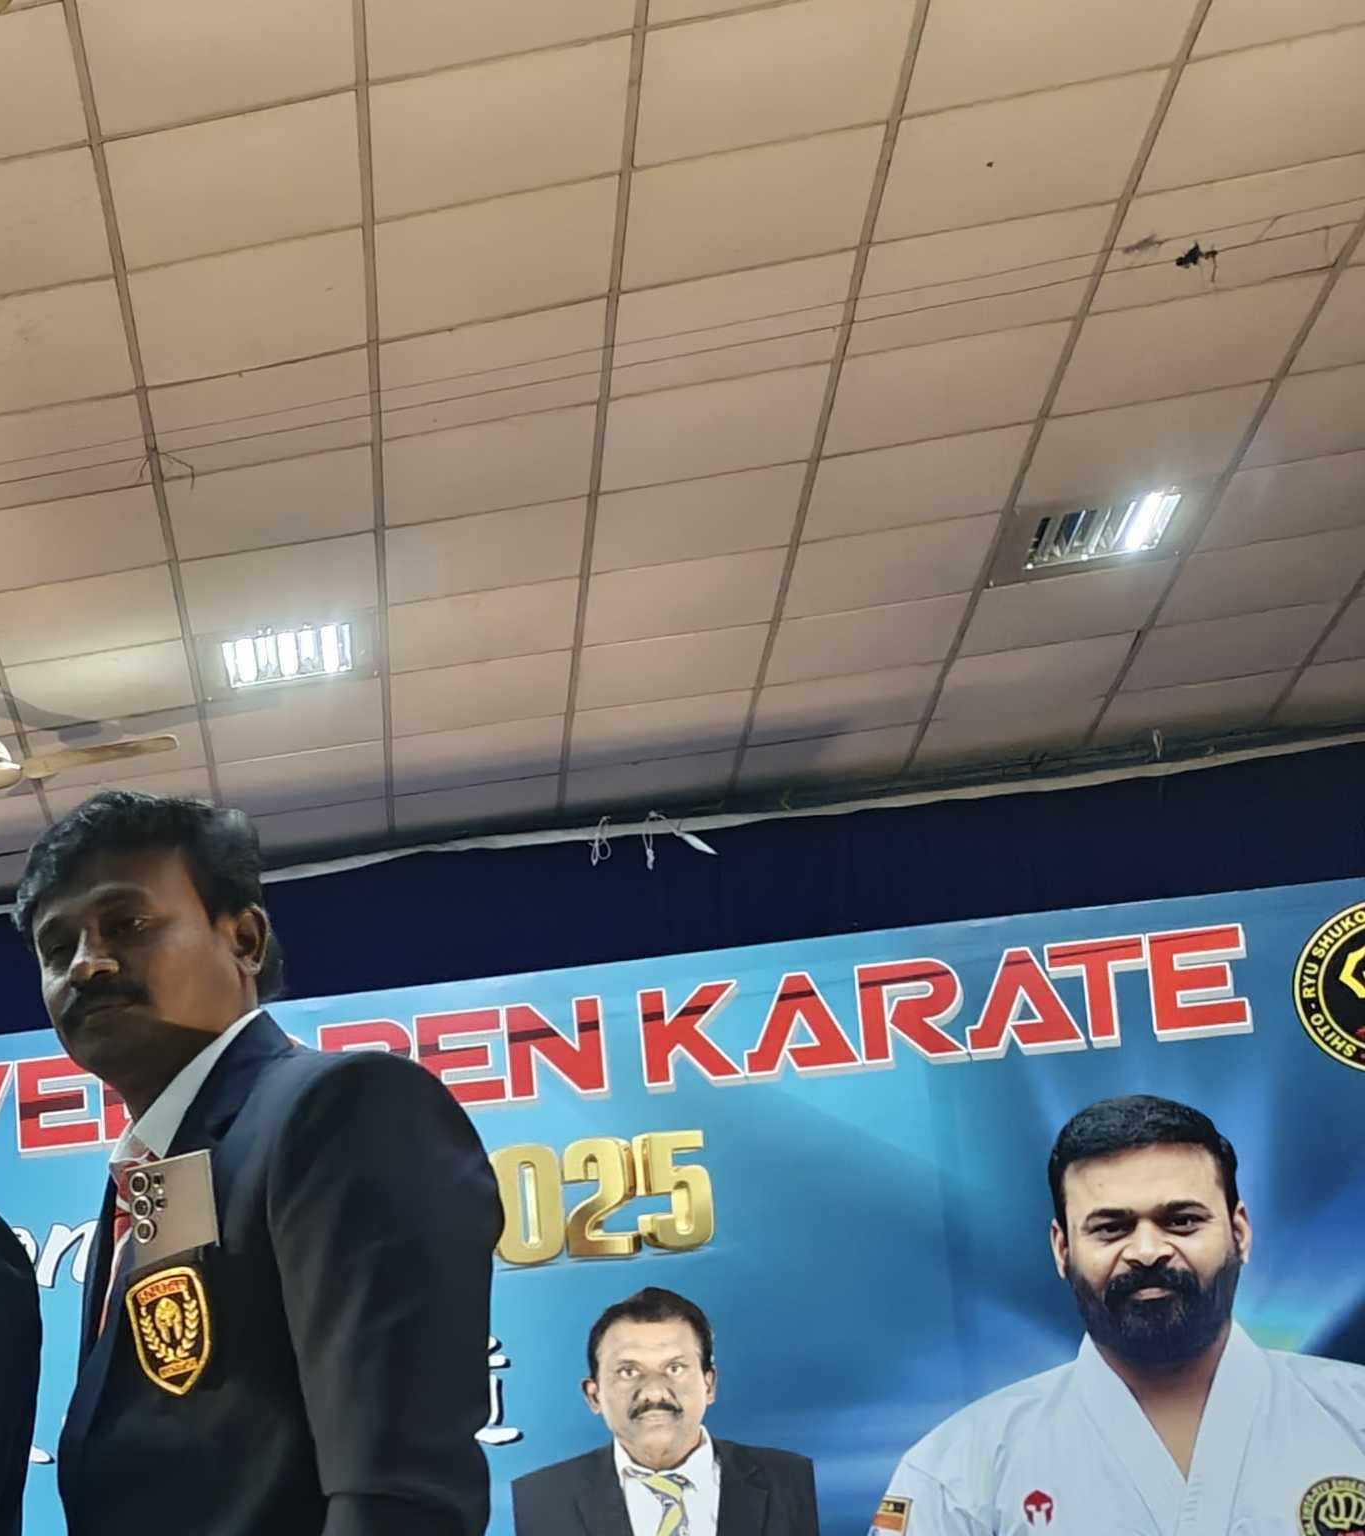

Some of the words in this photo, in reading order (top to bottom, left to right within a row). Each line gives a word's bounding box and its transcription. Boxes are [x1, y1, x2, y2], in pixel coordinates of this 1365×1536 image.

[1312, 909, 1365, 959] SHUKO
[1302, 961, 1319, 999] RYU
[636, 922, 1253, 1095] KARATE
[1311, 1012, 1358, 1058] SHITO
[491, 1129, 716, 1266] 025
